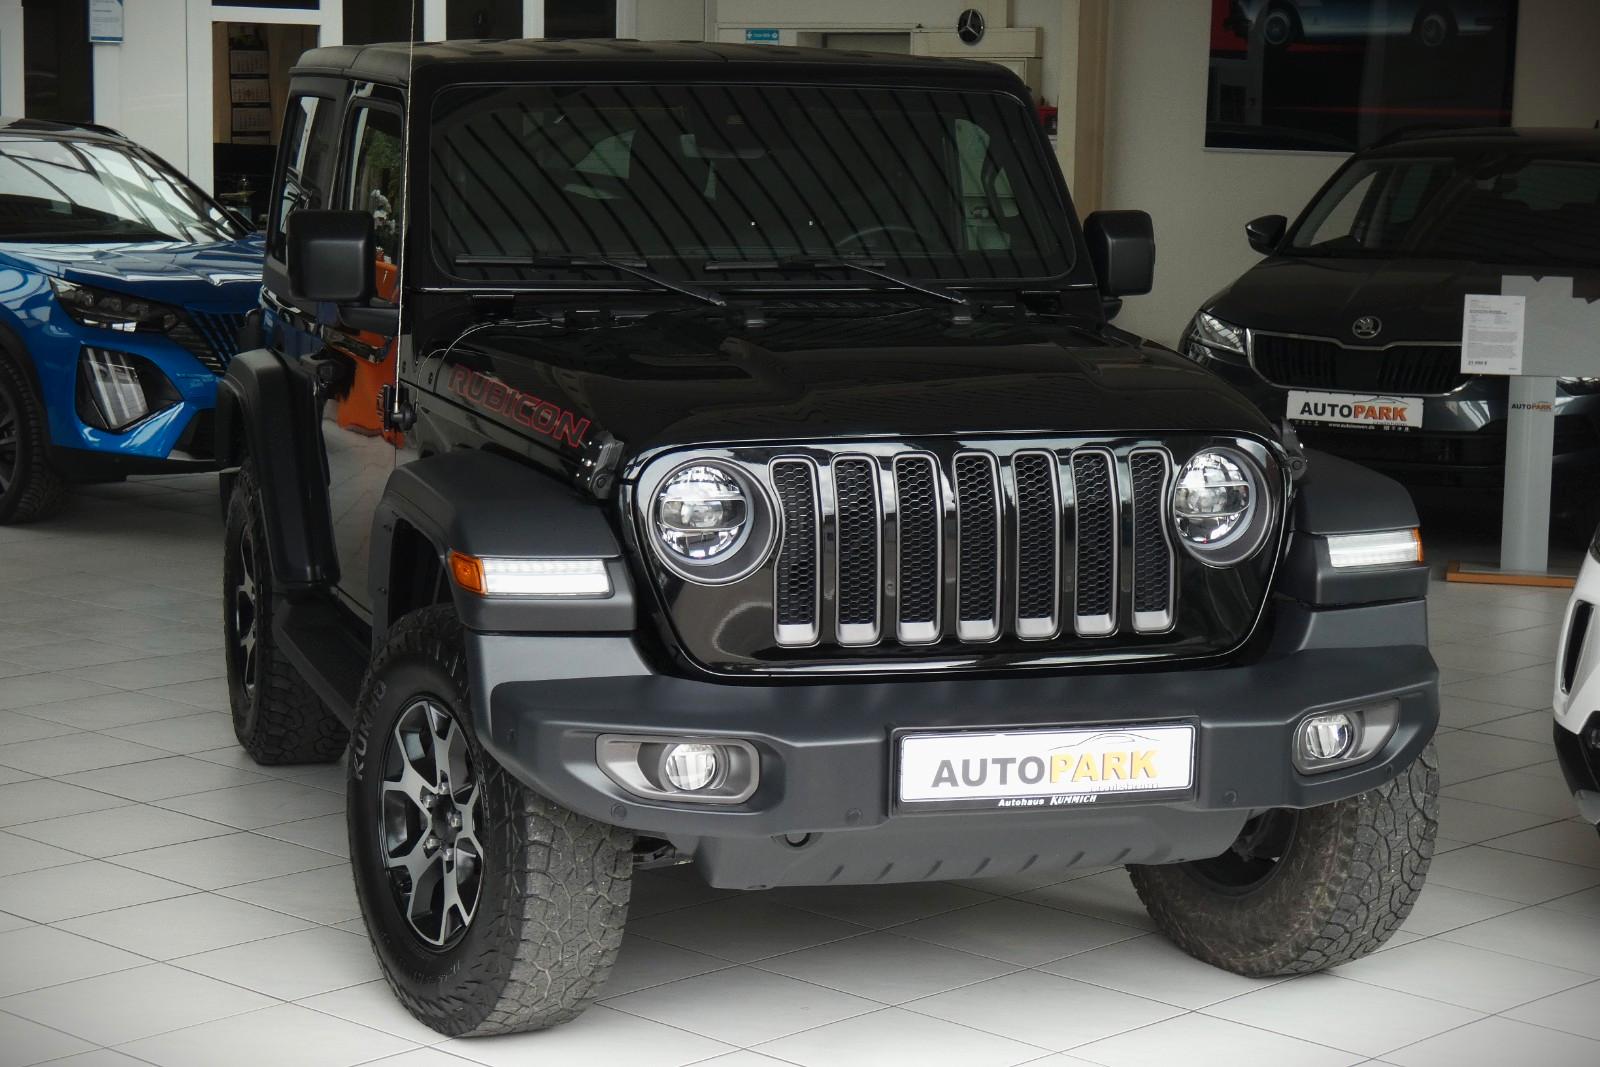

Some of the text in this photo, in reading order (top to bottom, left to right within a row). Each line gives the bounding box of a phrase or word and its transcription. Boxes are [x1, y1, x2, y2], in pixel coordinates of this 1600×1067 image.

[448, 363, 591, 448] RUBICON
[1300, 402, 1408, 421] AUTOPARK
[931, 750, 1160, 788] AUTOPARK
[998, 798, 1045, 807] Autohaus
